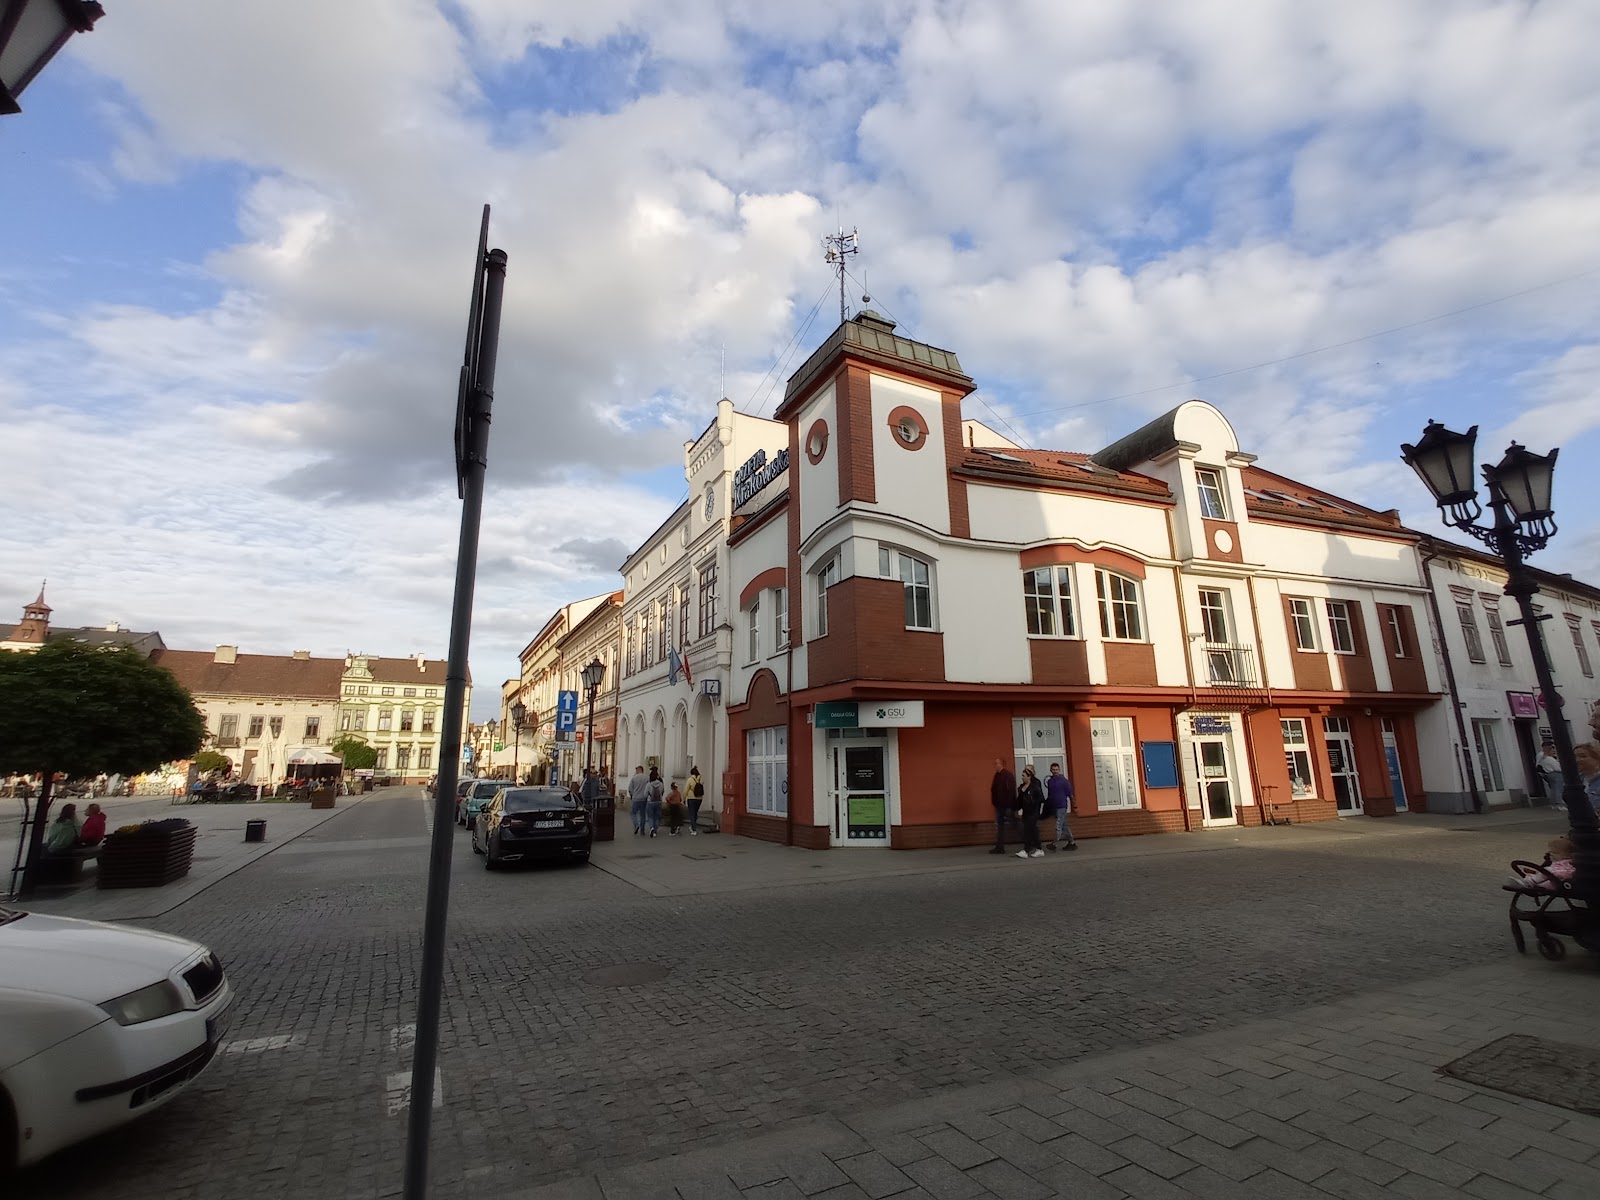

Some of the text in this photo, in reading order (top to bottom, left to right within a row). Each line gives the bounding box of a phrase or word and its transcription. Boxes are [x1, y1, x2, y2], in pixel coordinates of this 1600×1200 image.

[734, 447, 789, 510] Krakowska
[560, 712, 573, 730] P
[887, 708, 905, 717] GSU
